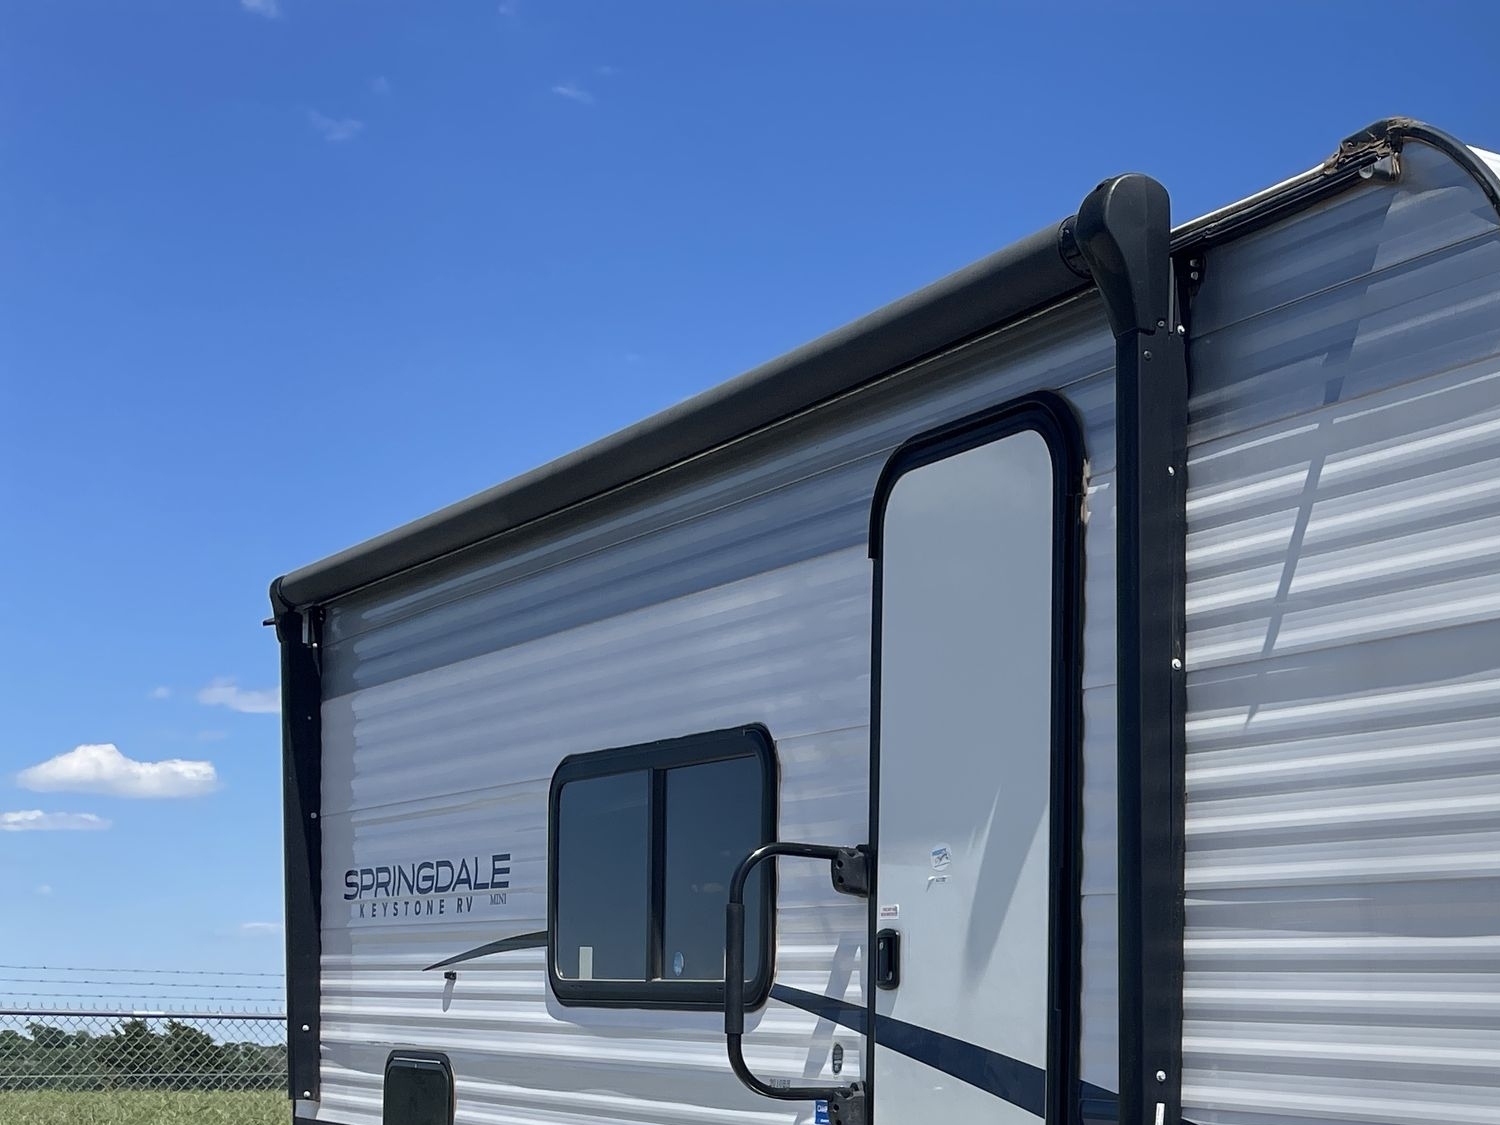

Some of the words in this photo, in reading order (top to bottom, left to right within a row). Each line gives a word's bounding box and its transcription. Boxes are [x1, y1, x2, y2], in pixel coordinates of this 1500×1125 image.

[343, 853, 511, 901] SPRINGDALE
[359, 898, 445, 918] KEYSTONE
[456, 896, 473, 914] RV
[489, 893, 507, 905] MINI
